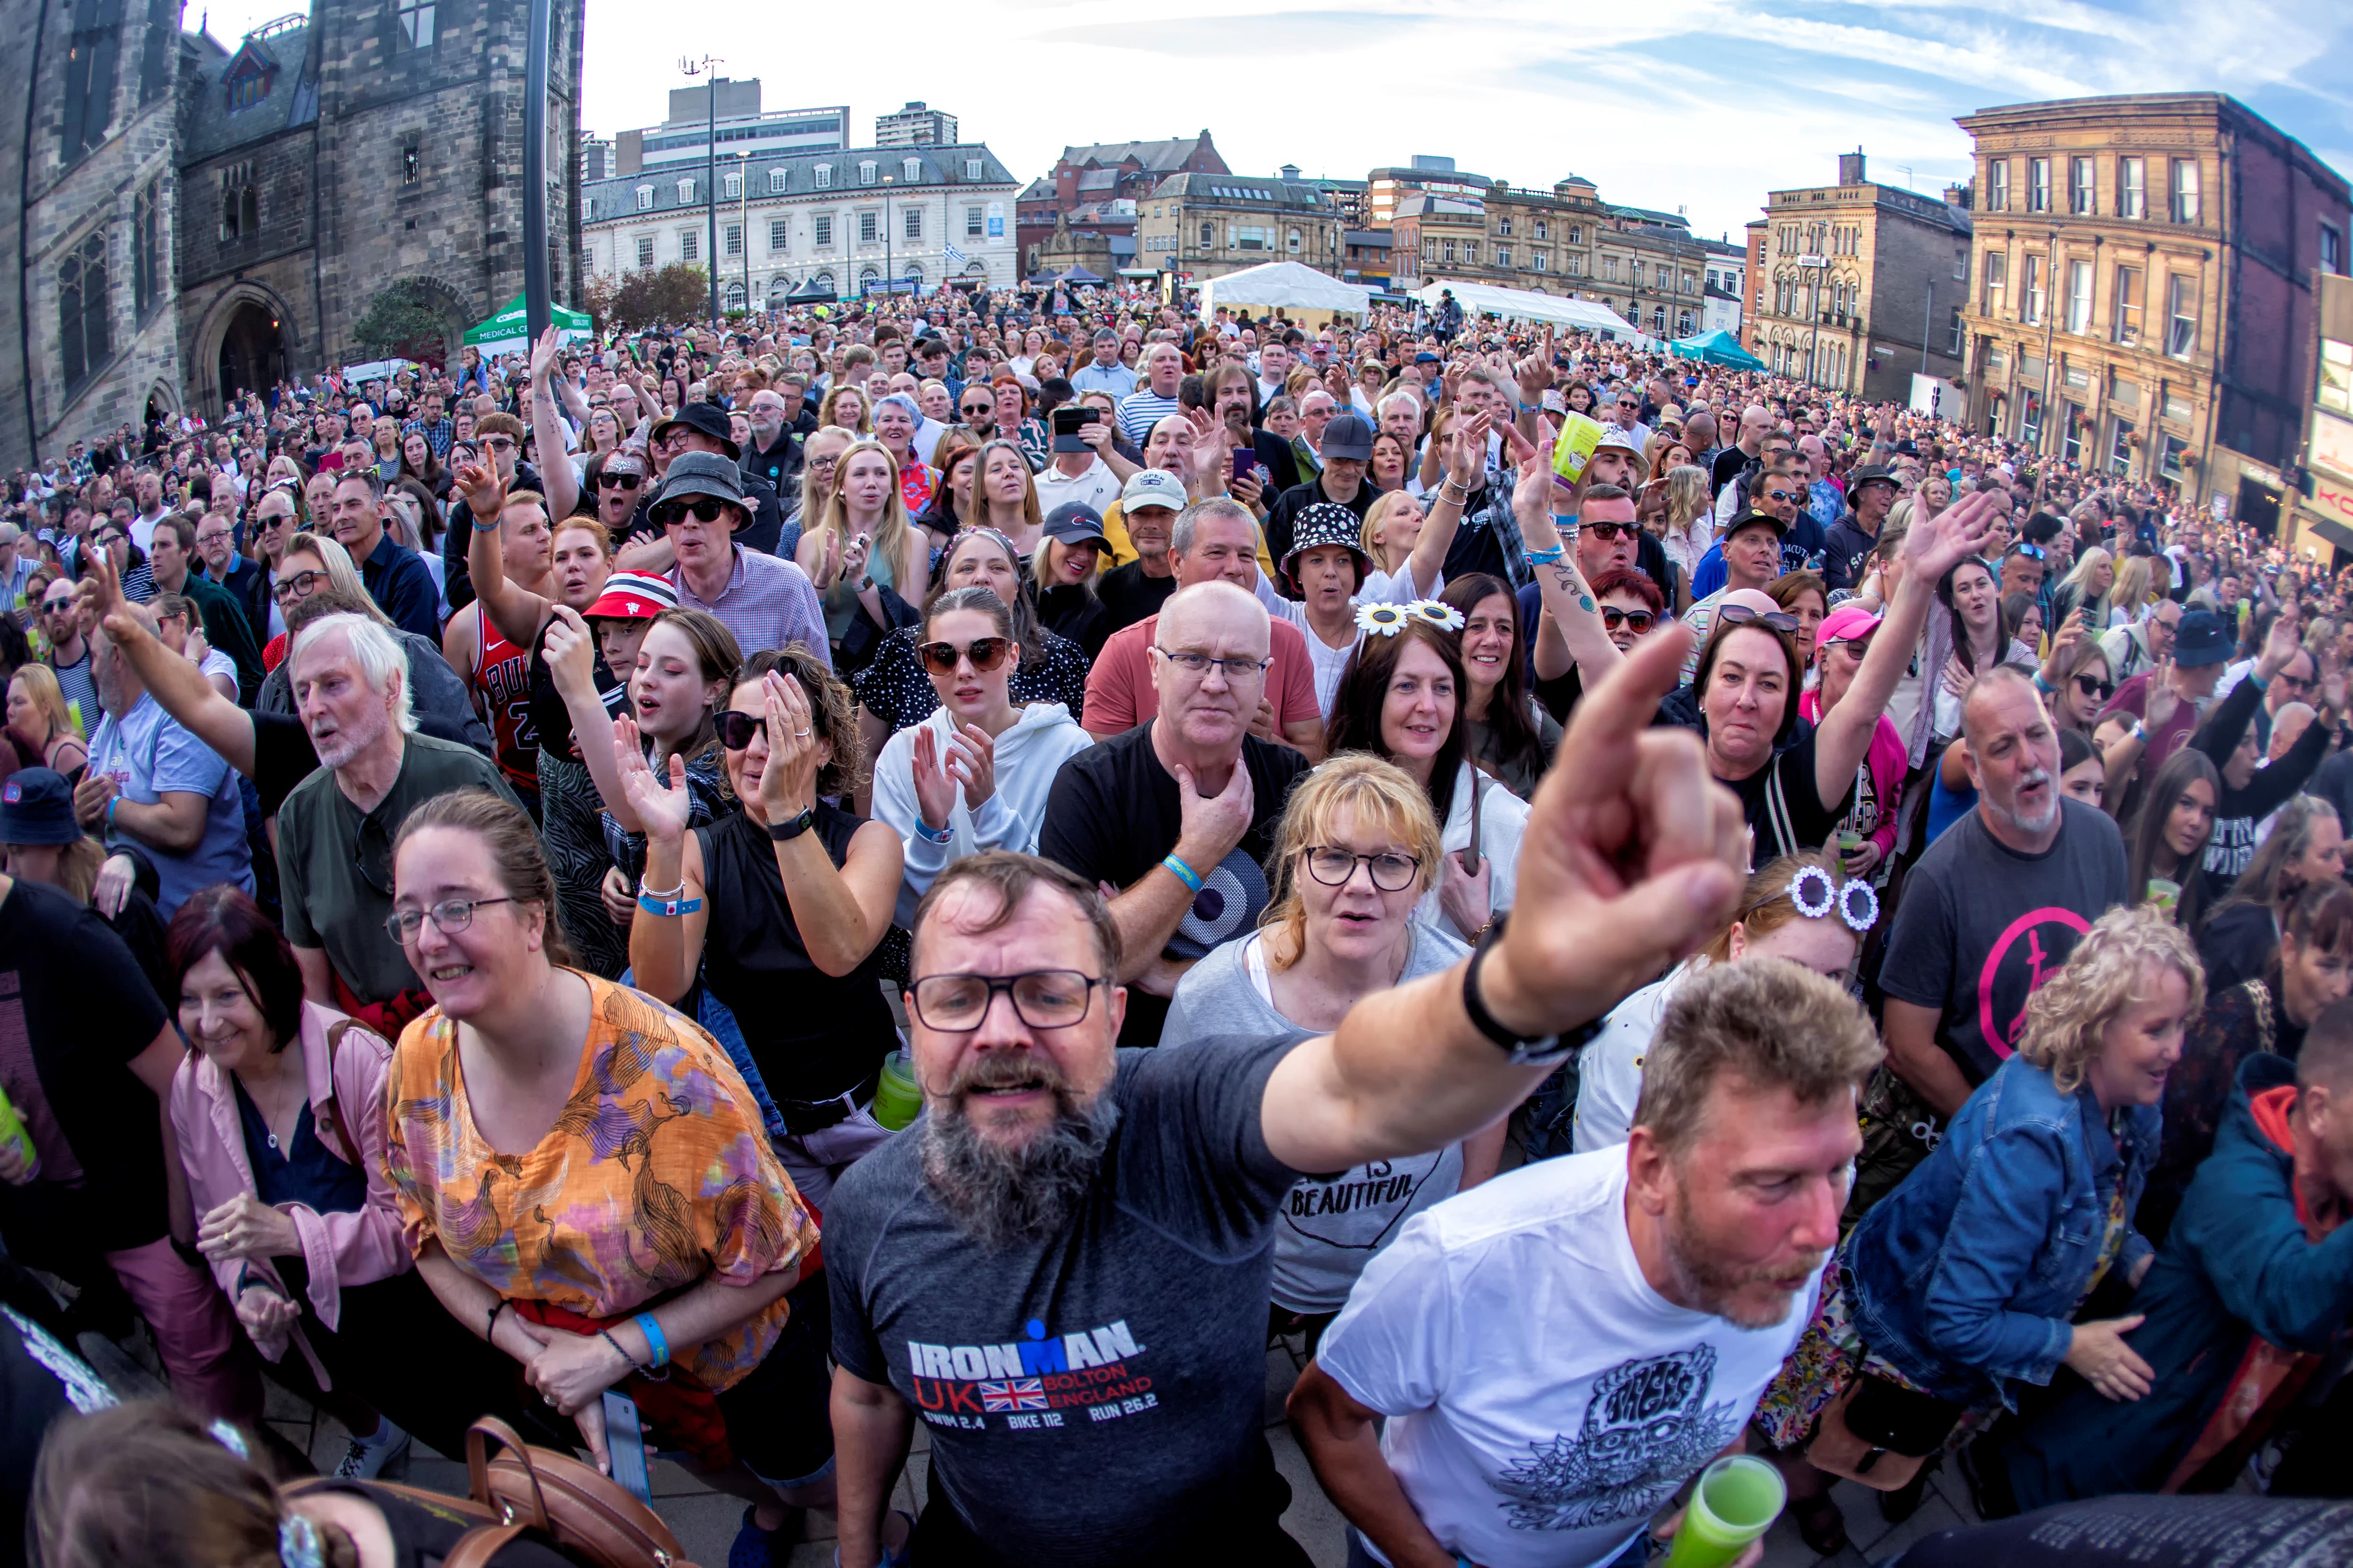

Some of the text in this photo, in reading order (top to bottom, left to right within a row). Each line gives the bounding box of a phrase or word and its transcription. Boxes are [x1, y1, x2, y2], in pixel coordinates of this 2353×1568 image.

[479, 325, 528, 340] MEDICAL CE
[1139, 473, 1165, 481] ASPEN
[1291, 1173, 1413, 1217] BEAUTIFUL
[907, 1319, 1139, 1381] IRONMAN
[913, 1376, 983, 1412] UK
[1043, 1363, 1127, 1391] BOLTON
[1049, 1376, 1153, 1408] ENGLAND
[924, 1392, 1159, 1430] SWIM 2.4 BIKE 112 RUN 26.2
